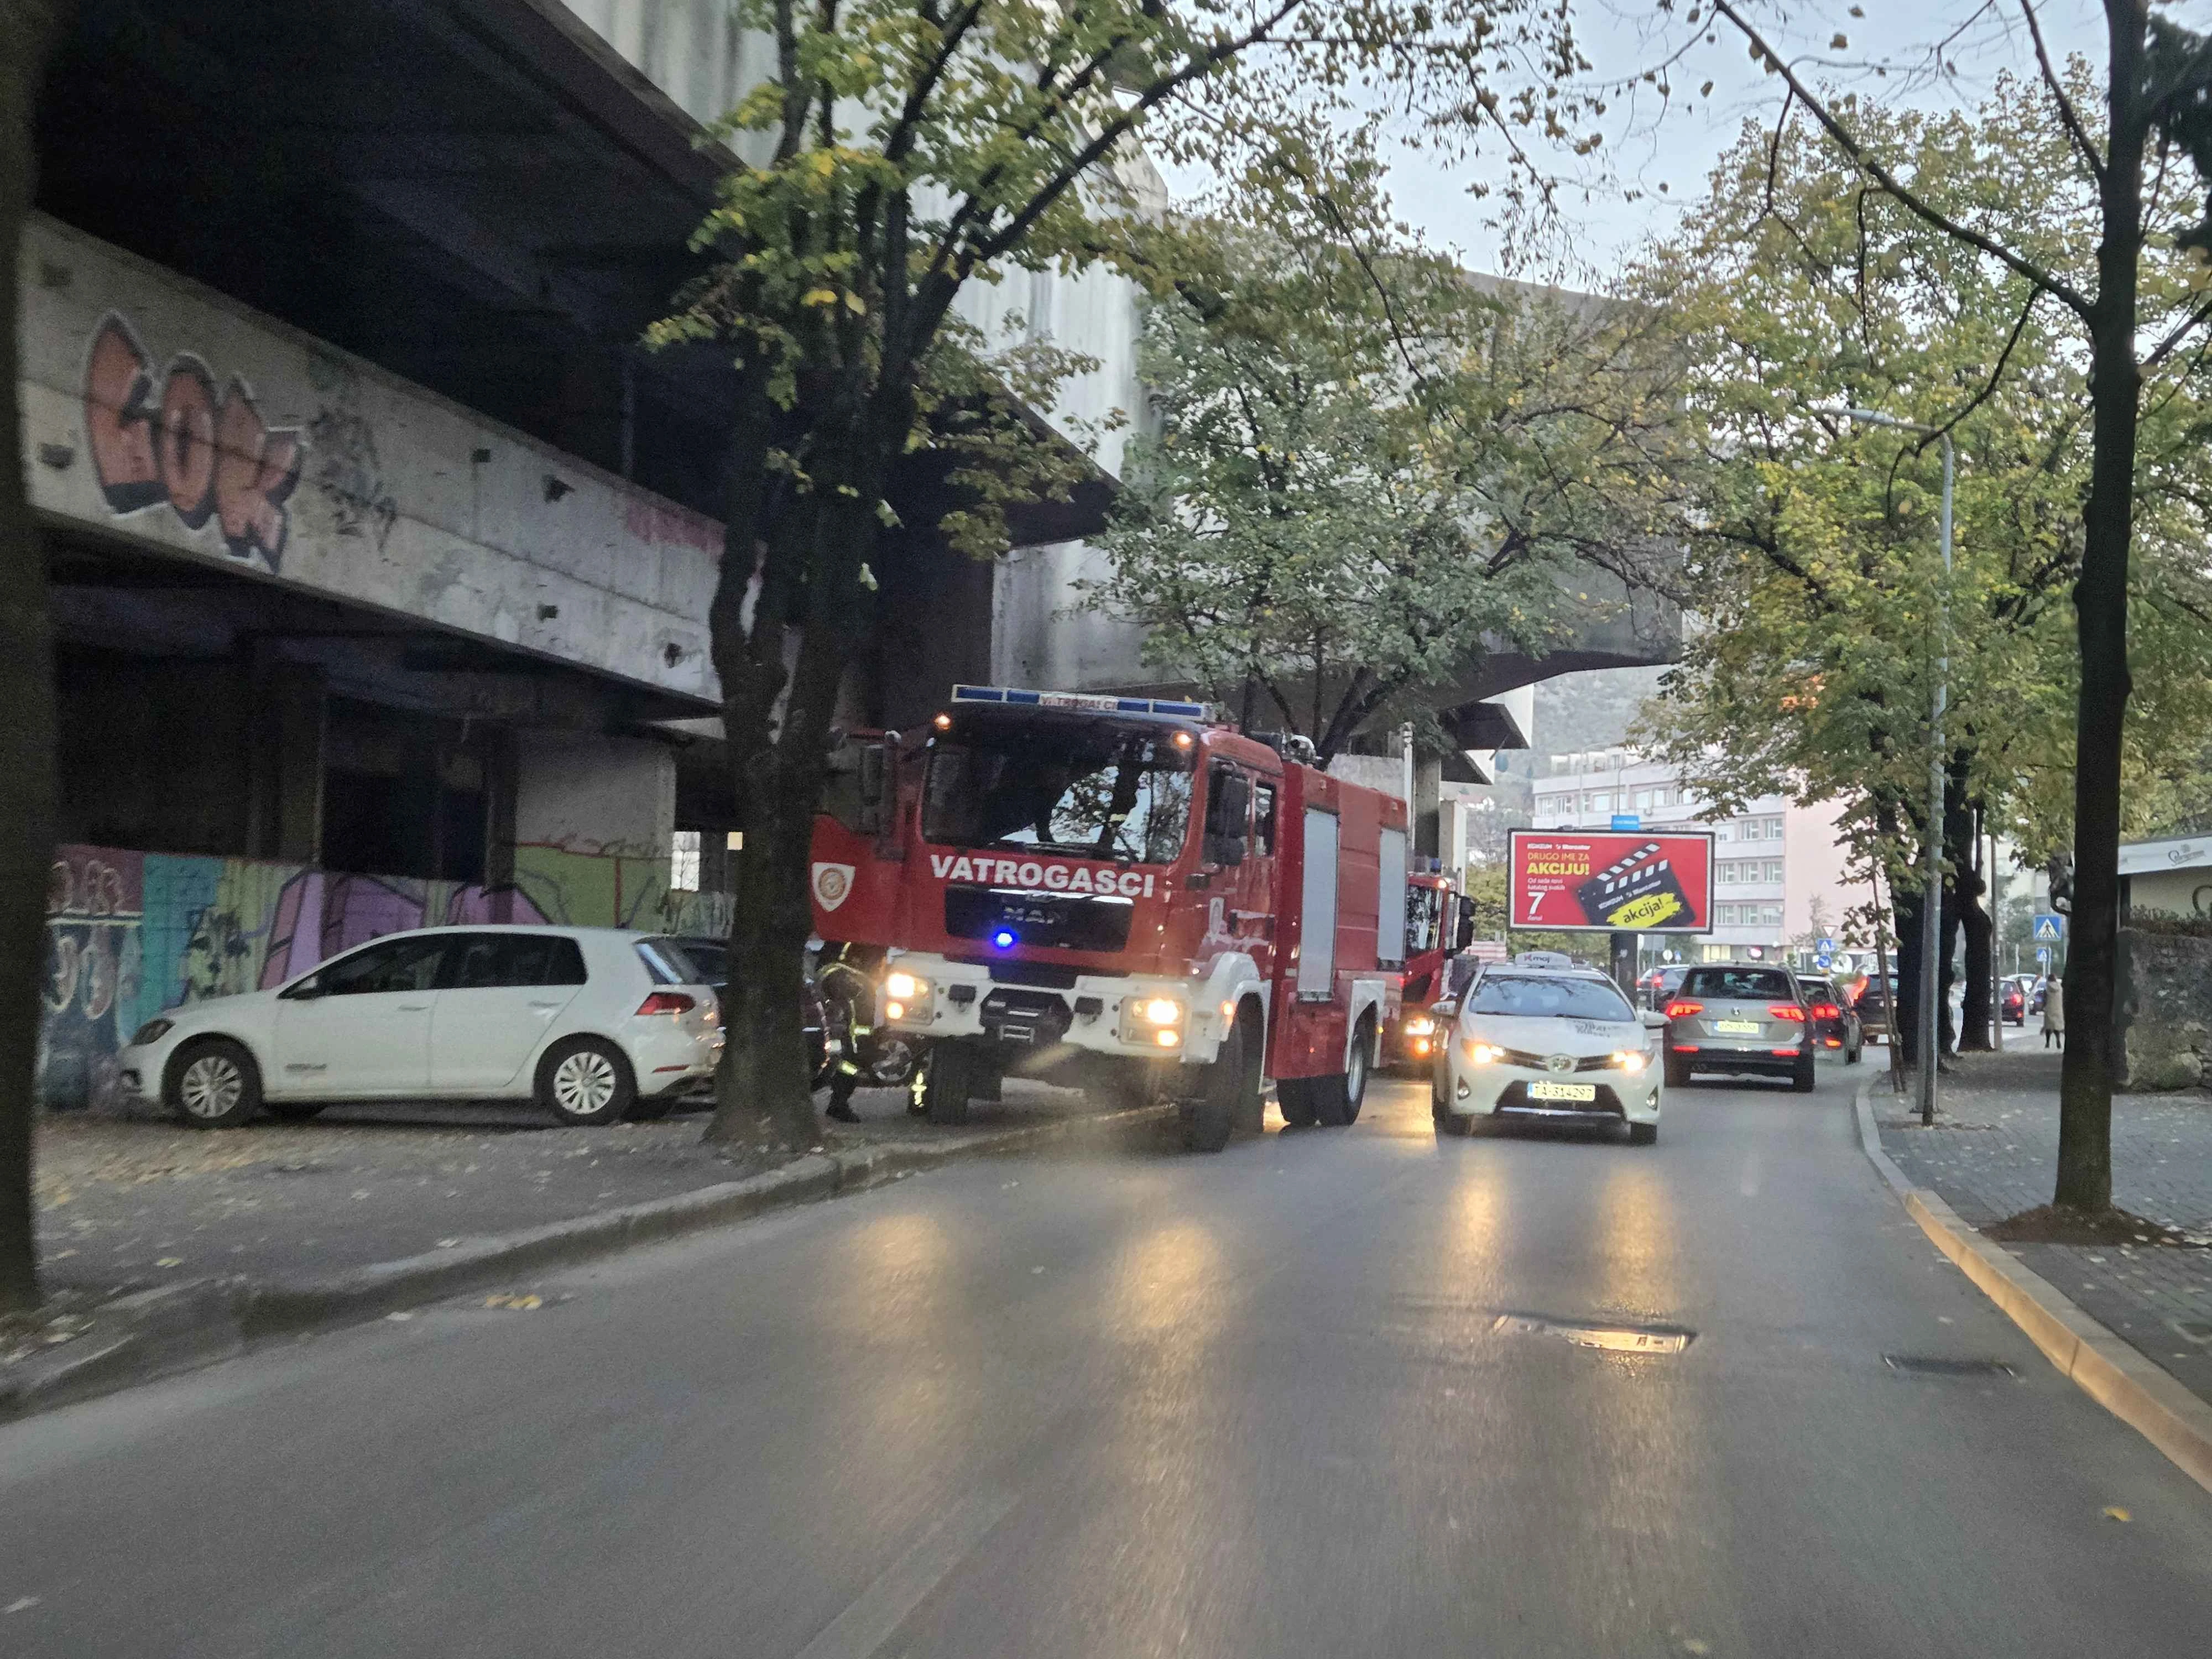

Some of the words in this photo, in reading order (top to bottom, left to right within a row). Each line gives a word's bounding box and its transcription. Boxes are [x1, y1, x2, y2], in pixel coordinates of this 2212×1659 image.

[1527, 862, 1590, 875] AKCIJU!
[1578, 853, 1590, 862] ZA
[930, 854, 1155, 898] VATROGASCI
[1528, 891, 1546, 915] 7
[1623, 898, 1665, 924] akcija!
